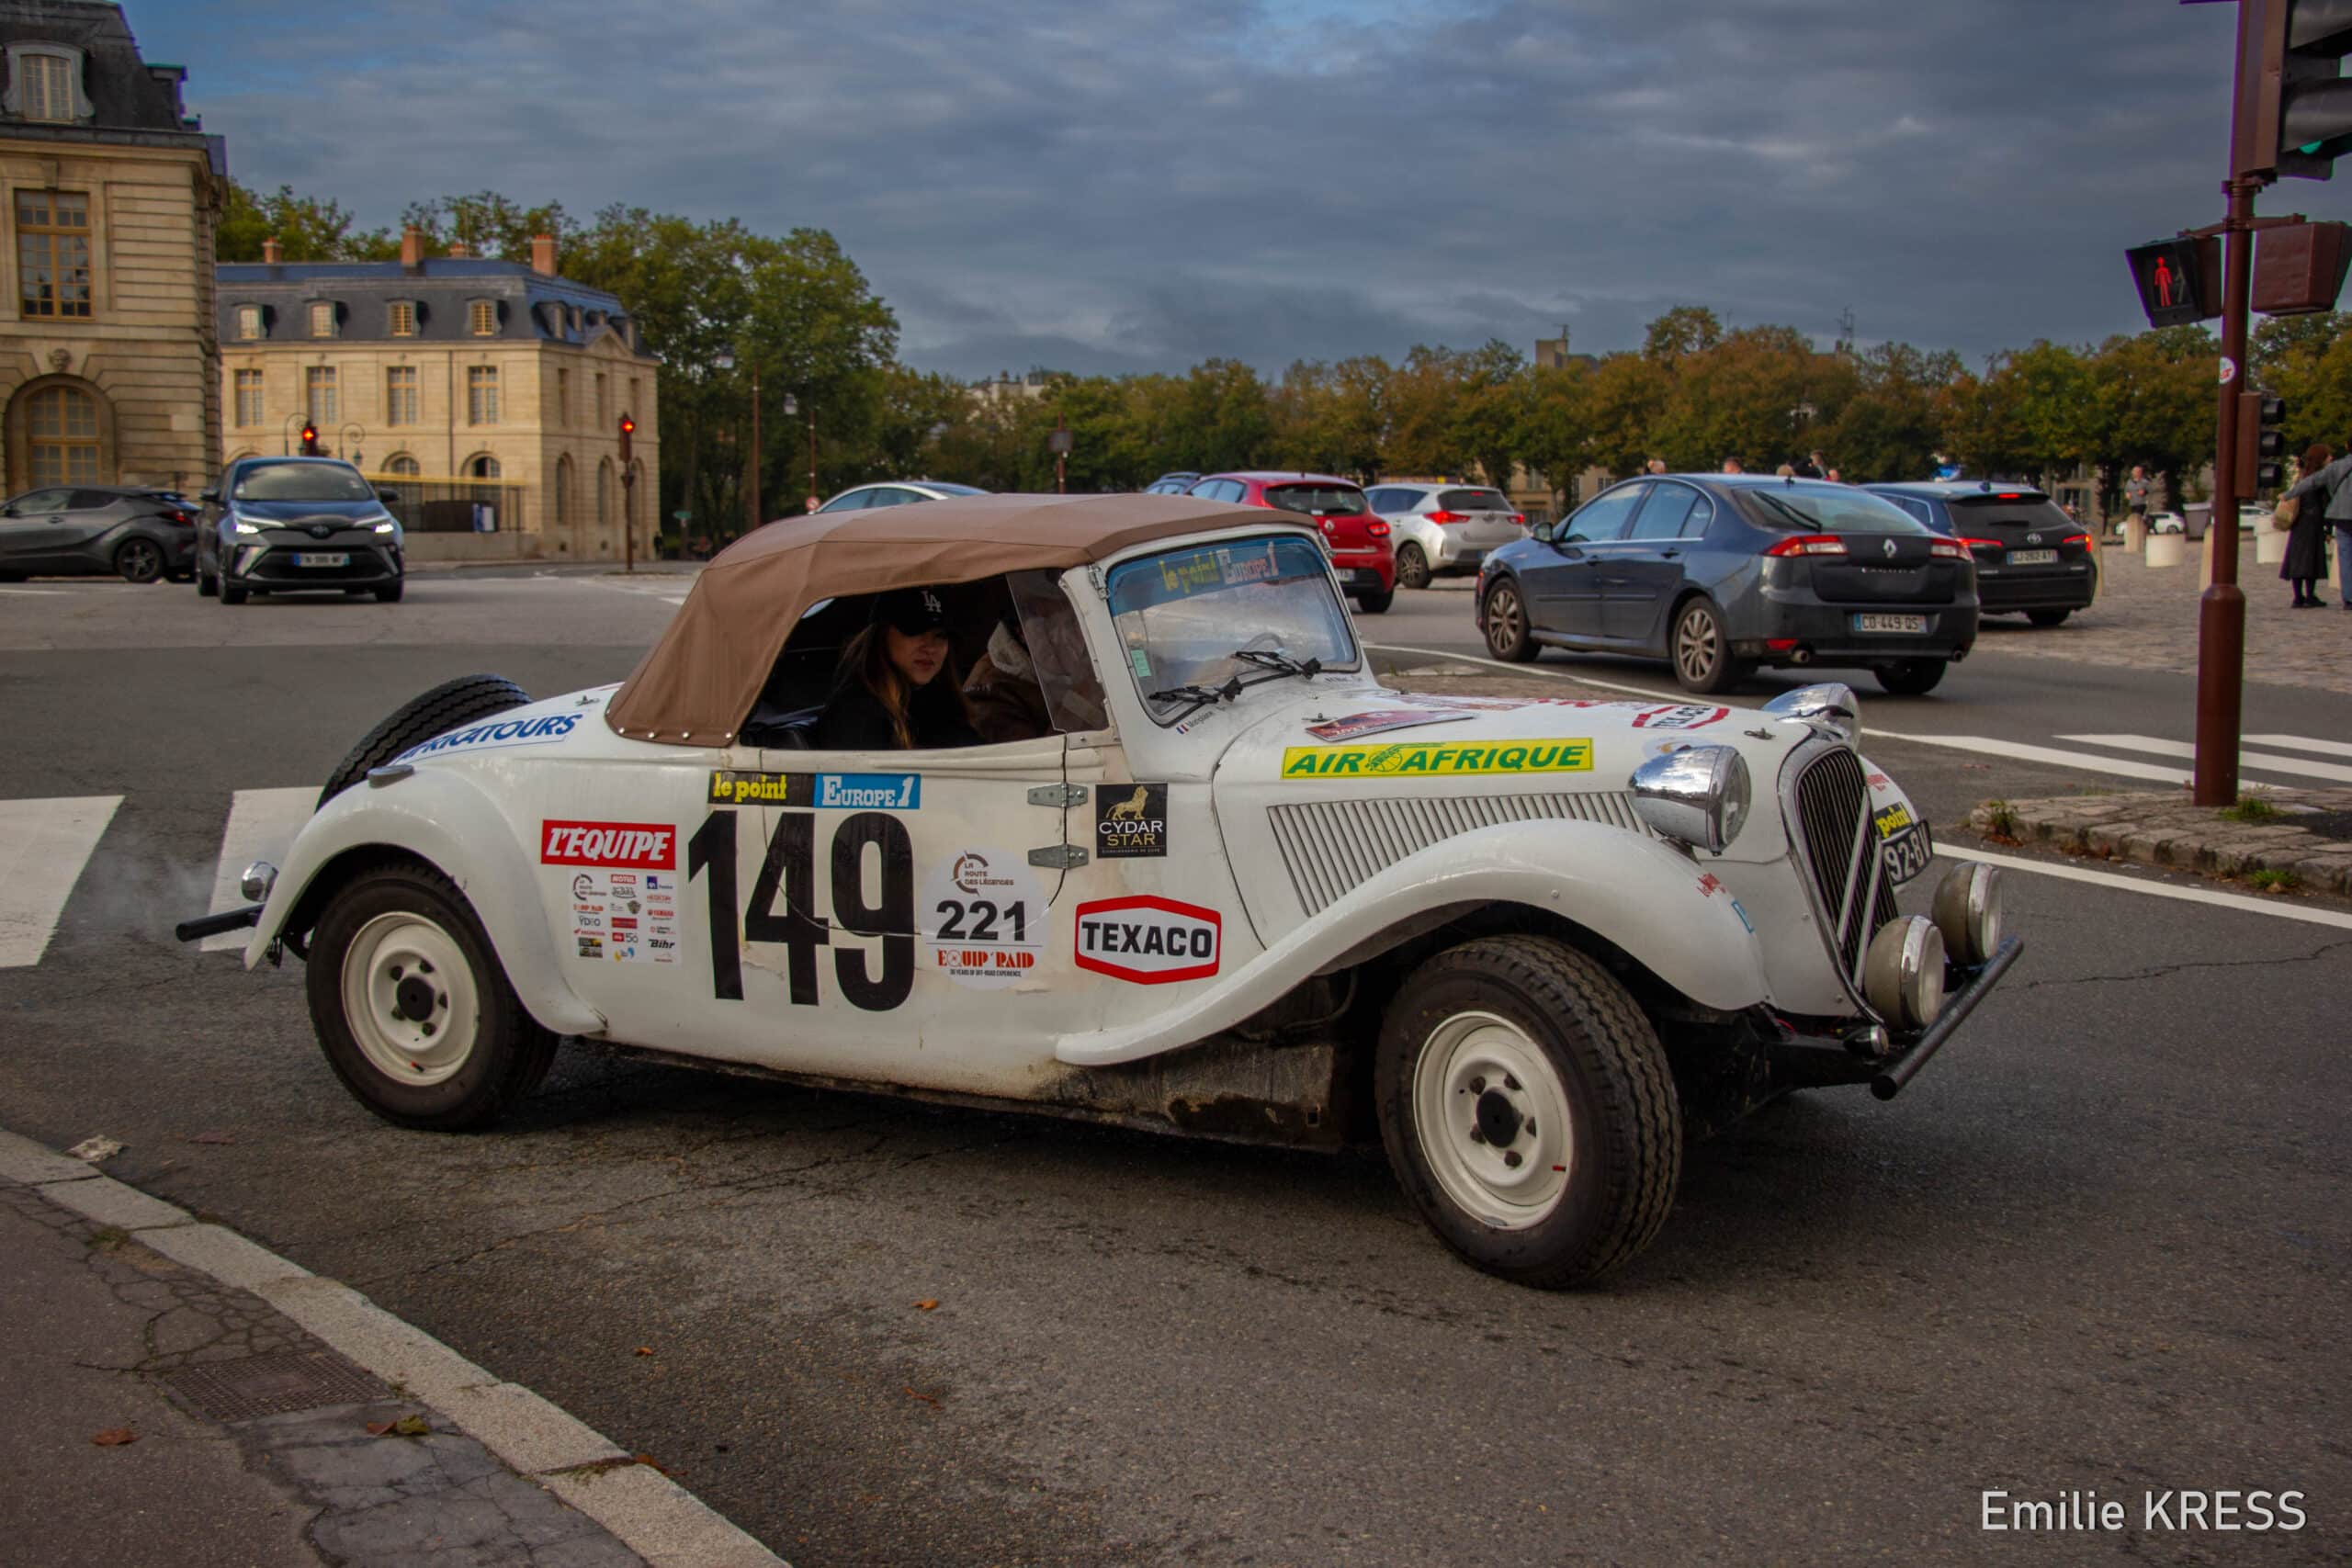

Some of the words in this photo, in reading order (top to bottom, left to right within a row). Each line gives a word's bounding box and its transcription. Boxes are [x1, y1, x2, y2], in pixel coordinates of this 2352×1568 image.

[921, 590, 942, 614] LA
[1287, 752, 1367, 773] AIR
[1398, 745, 1588, 771] AFRIQUE
[713, 773, 732, 797] le
[735, 774, 787, 804] point
[1099, 819, 1164, 835] CYDAR
[1107, 833, 1157, 847] STAR
[688, 809, 915, 1011] 149
[936, 899, 1025, 942] 221
[1081, 921, 1212, 958] TEXACO
